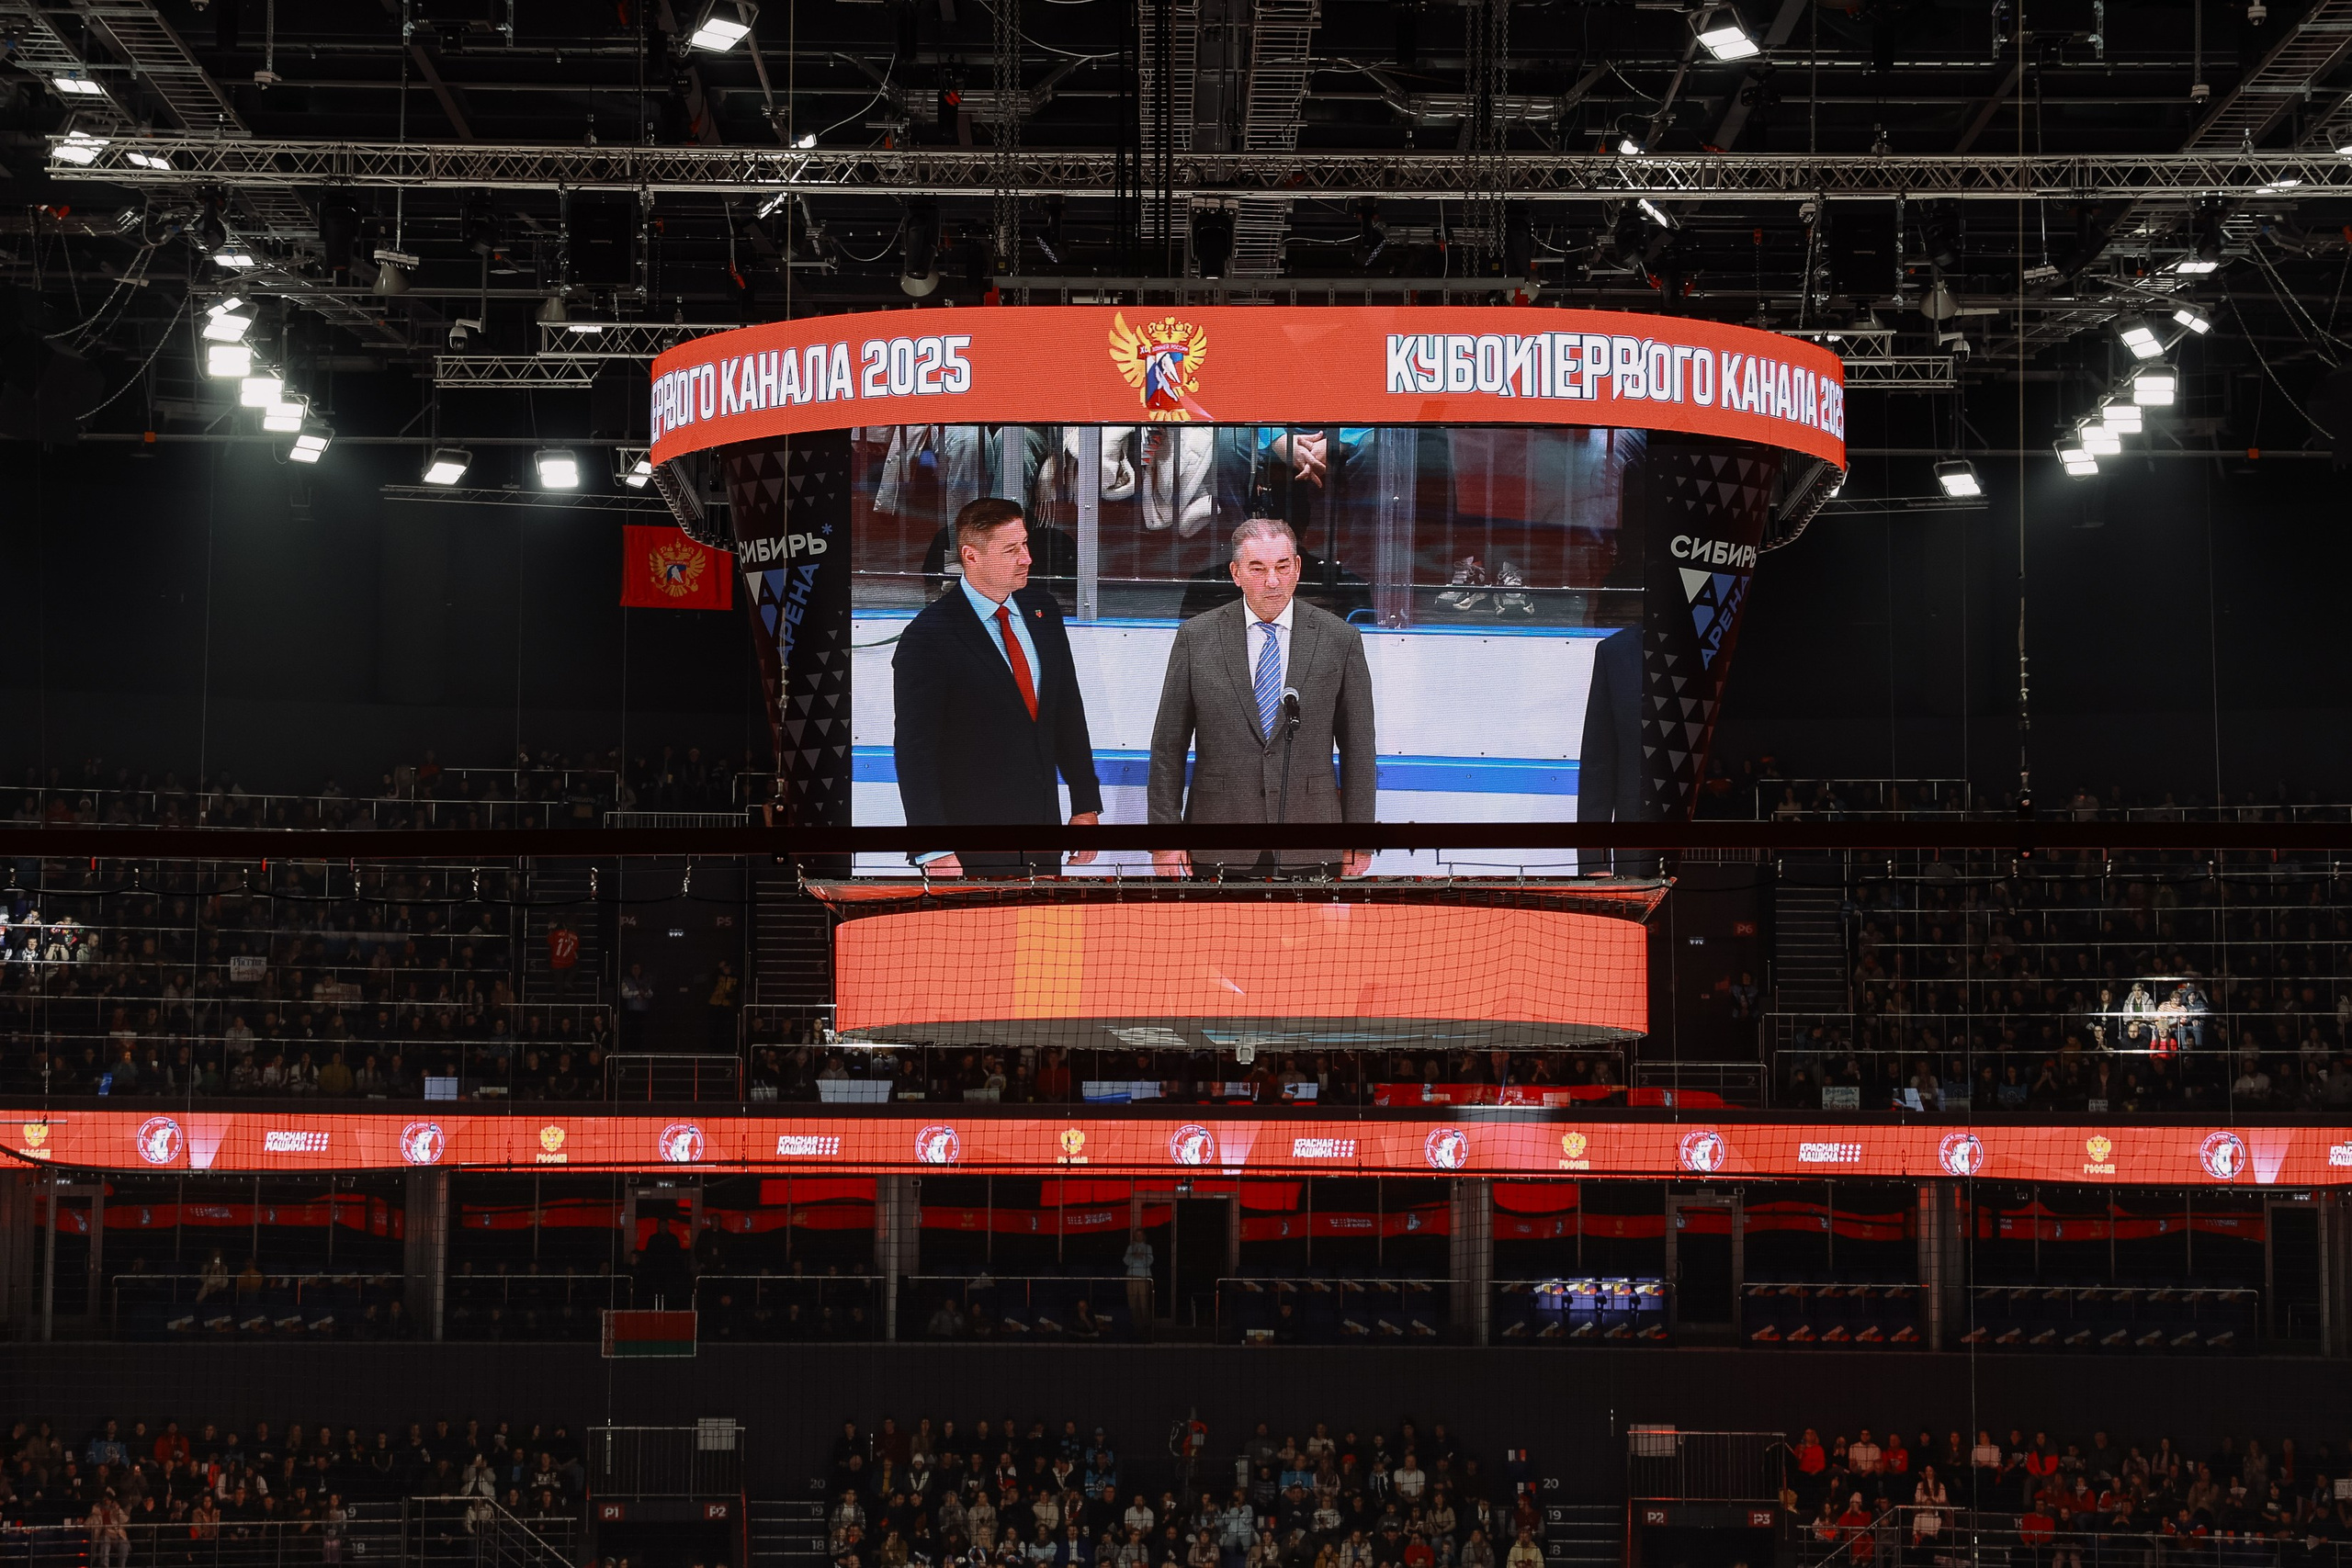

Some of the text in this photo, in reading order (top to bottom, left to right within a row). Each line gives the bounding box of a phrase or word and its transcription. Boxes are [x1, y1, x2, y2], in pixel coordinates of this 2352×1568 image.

[721, 342, 854, 417] КАНАЛА
[862, 335, 972, 397] 2025
[1721, 350, 1819, 428] КАНАЛА
[738, 532, 828, 565] СИБИРЬ
[1670, 535, 1757, 569] СИБИРЬ
[776, 563, 820, 667] АРЕНА
[1701, 576, 1751, 671] АРЕНА
[725, 1068, 733, 1077] 2
[1747, 1076, 1756, 1086] 2
[266, 1132, 308, 1141] КРАСНАЯ
[778, 1135, 819, 1145] КРАСНАЯ
[264, 1140, 305, 1151] МАШИНА
[1295, 1138, 1334, 1147] КРАСНАЯ
[1800, 1143, 1840, 1152] КРАСНАЯ
[776, 1144, 817, 1155] МАШИНА
[1293, 1146, 1333, 1157] МАШИНА
[1798, 1151, 1839, 1162] МАШИНА
[810, 1478, 826, 1489] 20
[1544, 1478, 1559, 1489] 20
[605, 1506, 619, 1517] P1
[709, 1506, 726, 1517] P2
[811, 1506, 823, 1517] 19
[1548, 1510, 1561, 1520] 19
[1647, 1512, 1664, 1523] P2
[1754, 1513, 1770, 1525] P3
[812, 1540, 824, 1551] 18
